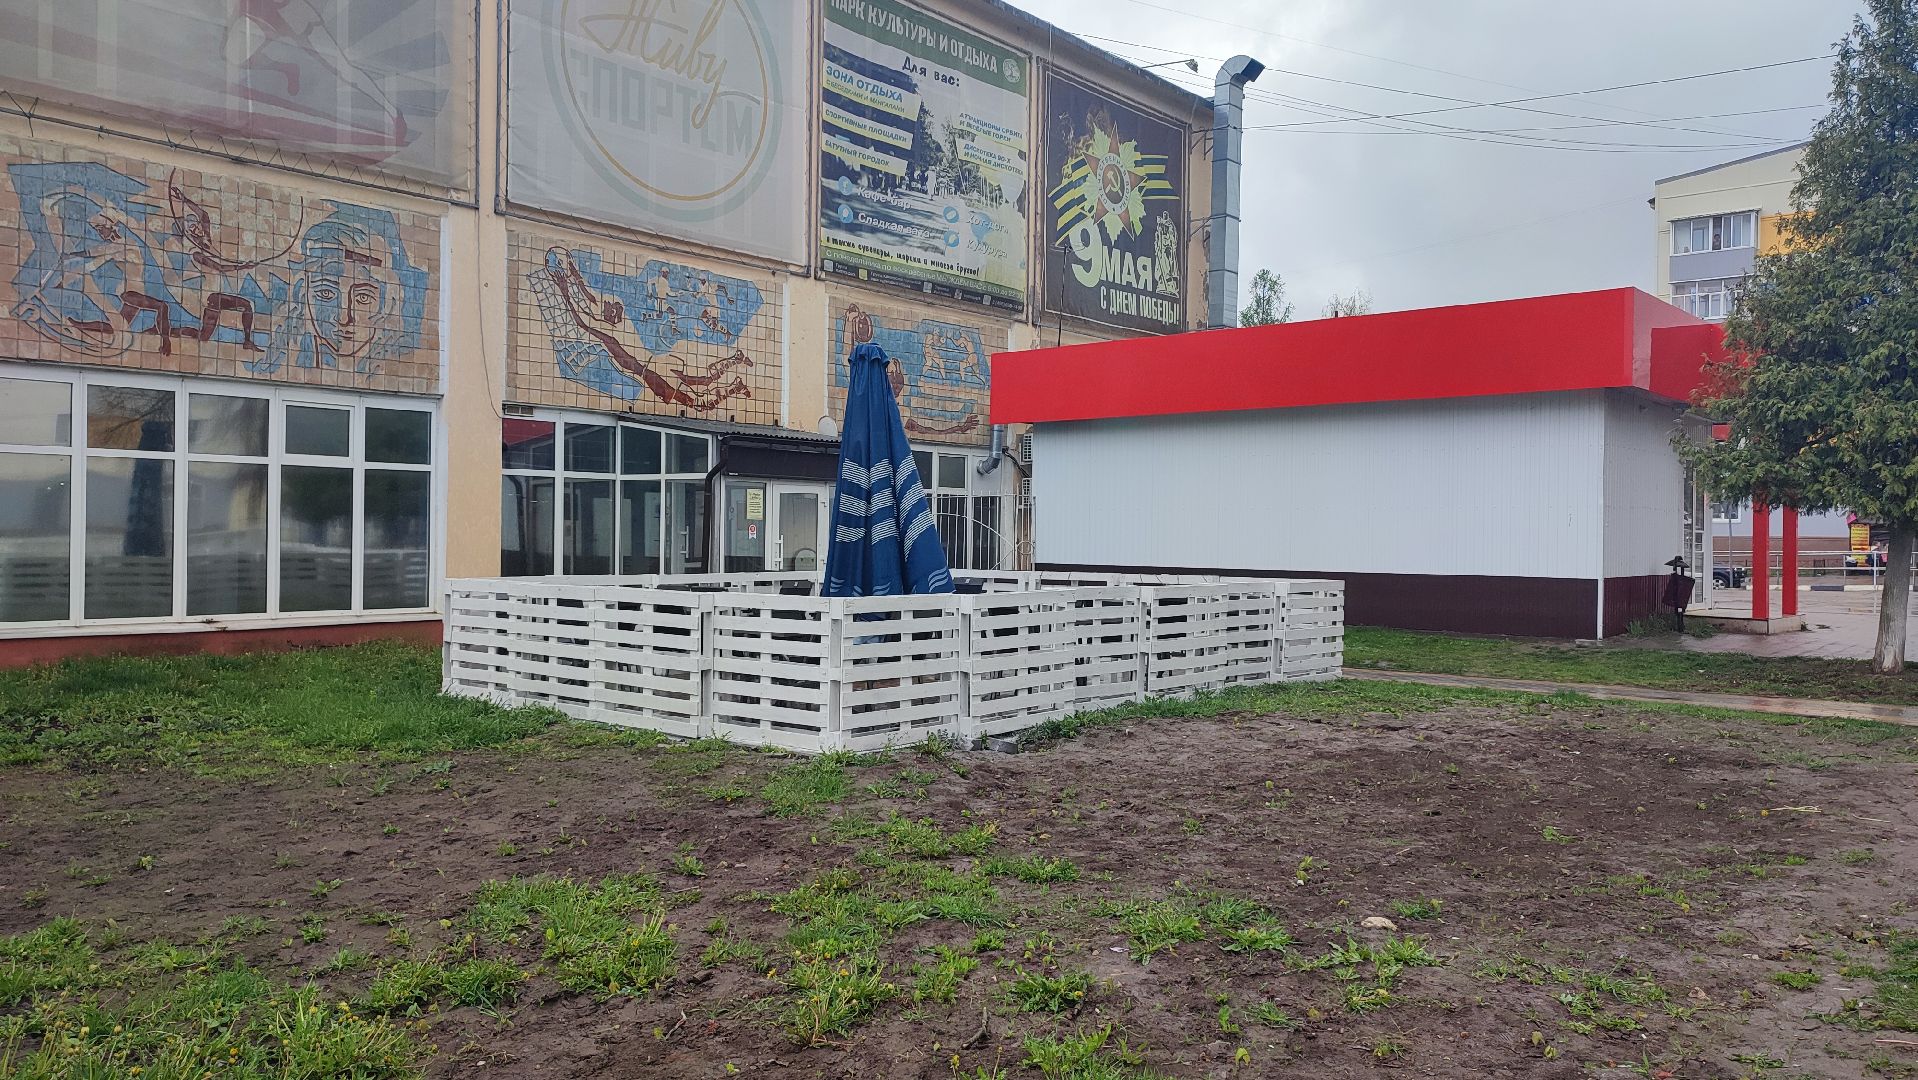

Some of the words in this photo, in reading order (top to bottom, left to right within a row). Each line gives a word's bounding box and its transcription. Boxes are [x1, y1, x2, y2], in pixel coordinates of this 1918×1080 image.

[831, 0, 866, 20] ПАРК
[868, 4, 937, 48] КУЛЬТУРЫ
[939, 34, 948, 53] И
[950, 39, 998, 74] ОТДЫХА
[826, 65, 854, 86] ЗОНА
[856, 79, 903, 103] ОТДЫХА
[902, 56, 927, 77] Для
[934, 71, 960, 87] вас:
[869, 97, 905, 113] МАНГАЛАМИ
[825, 109, 867, 130] СПОРТИВНЫЕ
[868, 126, 907, 143] ПЛОЩАДКИ
[959, 112, 1000, 132] АТТРАКЦИОНЫ
[992, 131, 1011, 143] ГОРКИ
[825, 139, 857, 156] БАТУТНЫЙ
[858, 152, 890, 166] ГОРОДОК
[963, 143, 997, 160] ДИСКОТЕКА
[969, 152, 992, 165] НОЧНАЯ
[857, 187, 911, 210] Кафе-бар
[858, 212, 903, 232] Сладкая
[905, 226, 931, 238] вата
[831, 237, 856, 249] также
[930, 259, 954, 271] многое
[833, 252, 881, 270] понедельника
[1069, 219, 1102, 288] 9
[1100, 245, 1153, 292] МАЯ
[1100, 285, 1107, 310] С
[1109, 288, 1137, 317] ДНЕМ
[1139, 294, 1180, 326] ПОБЕДЫ!
